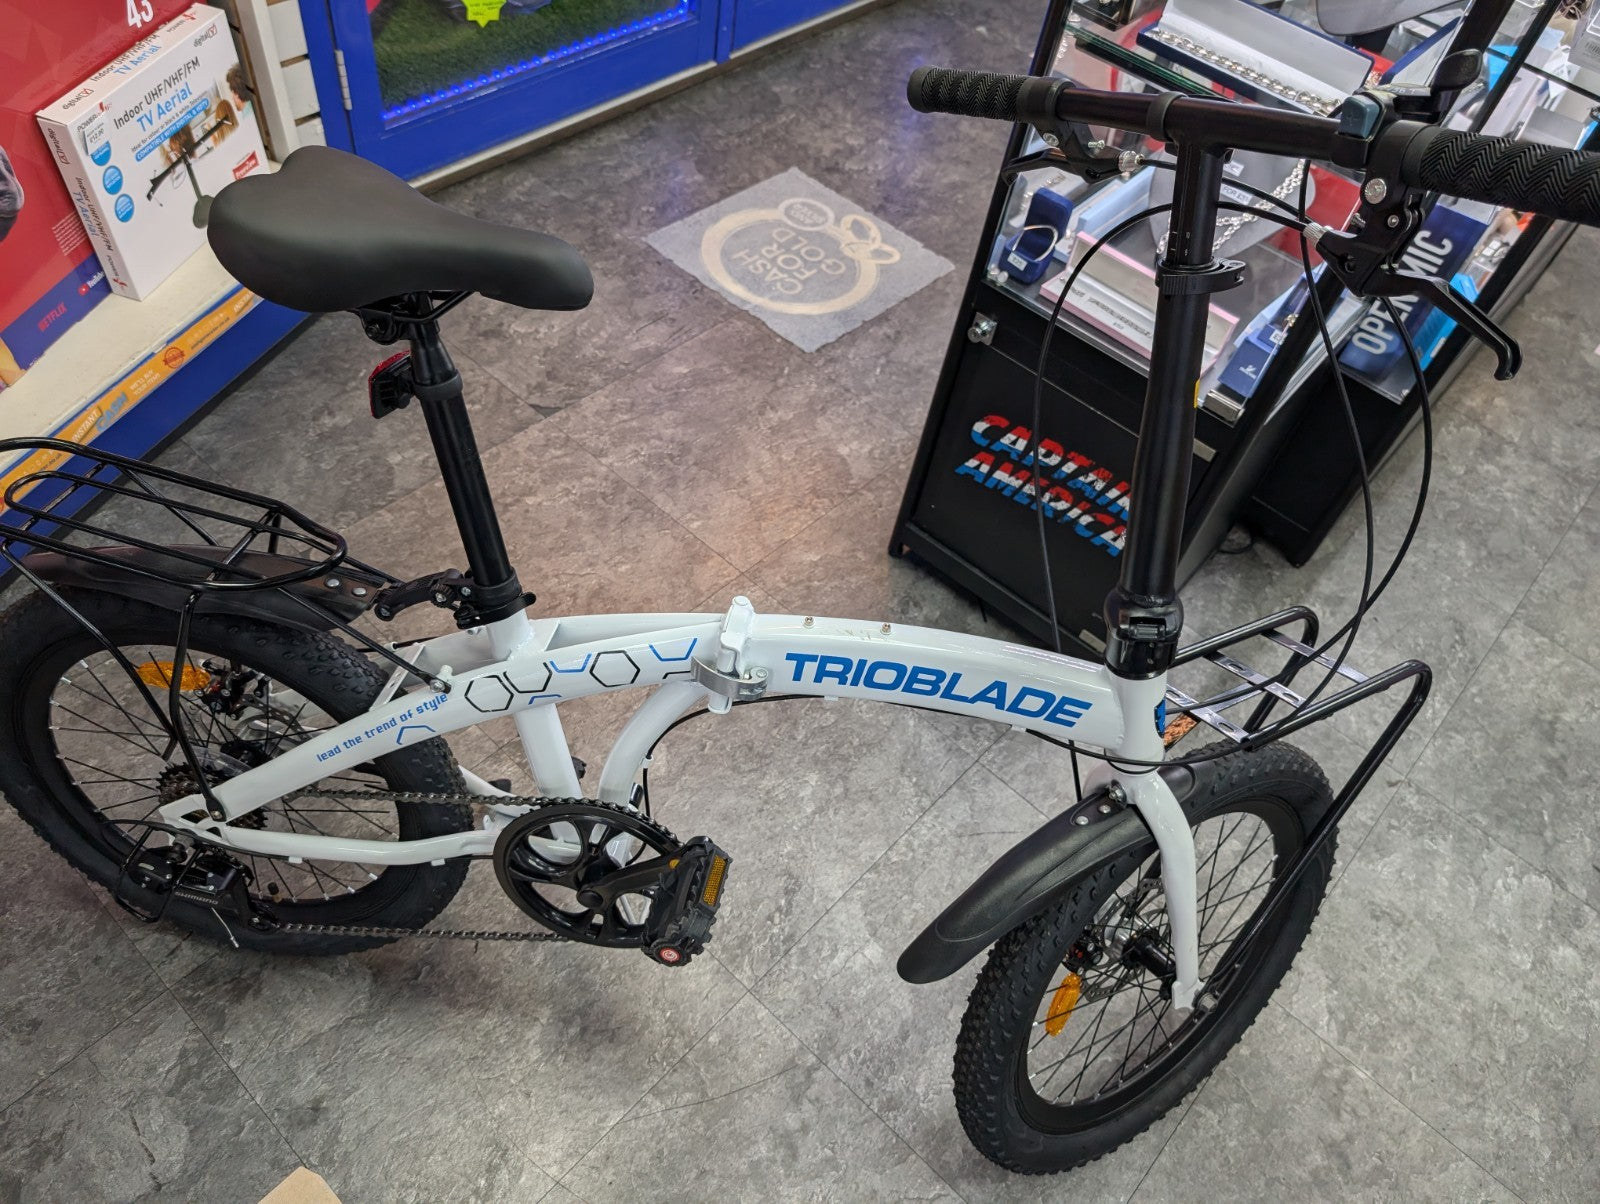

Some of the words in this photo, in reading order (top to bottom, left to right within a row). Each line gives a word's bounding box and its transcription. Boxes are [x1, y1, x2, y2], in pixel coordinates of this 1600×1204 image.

[91, 65, 116, 82] Indoor
[113, 65, 131, 76] TV
[131, 44, 163, 66] Aerial
[113, 102, 144, 130] Indoor
[144, 56, 201, 106] UHF/VHF/FM
[136, 109, 154, 132] TV
[156, 81, 193, 120] Aerial
[75, 177, 91, 202] Indoor
[72, 191, 86, 207] TV
[79, 206, 100, 237] Aerial
[731, 249, 803, 294] CASH
[761, 243, 818, 280] FOR
[772, 228, 847, 275] GOLD
[38, 302, 67, 332] NETFLIX
[95, 391, 128, 432] CASH
[785, 652, 1093, 727] TRIOBLADE
[316, 745, 342, 762] lead
[343, 735, 363, 750] the
[364, 718, 398, 739] trend
[400, 709, 413, 722] of
[415, 693, 449, 714] style
